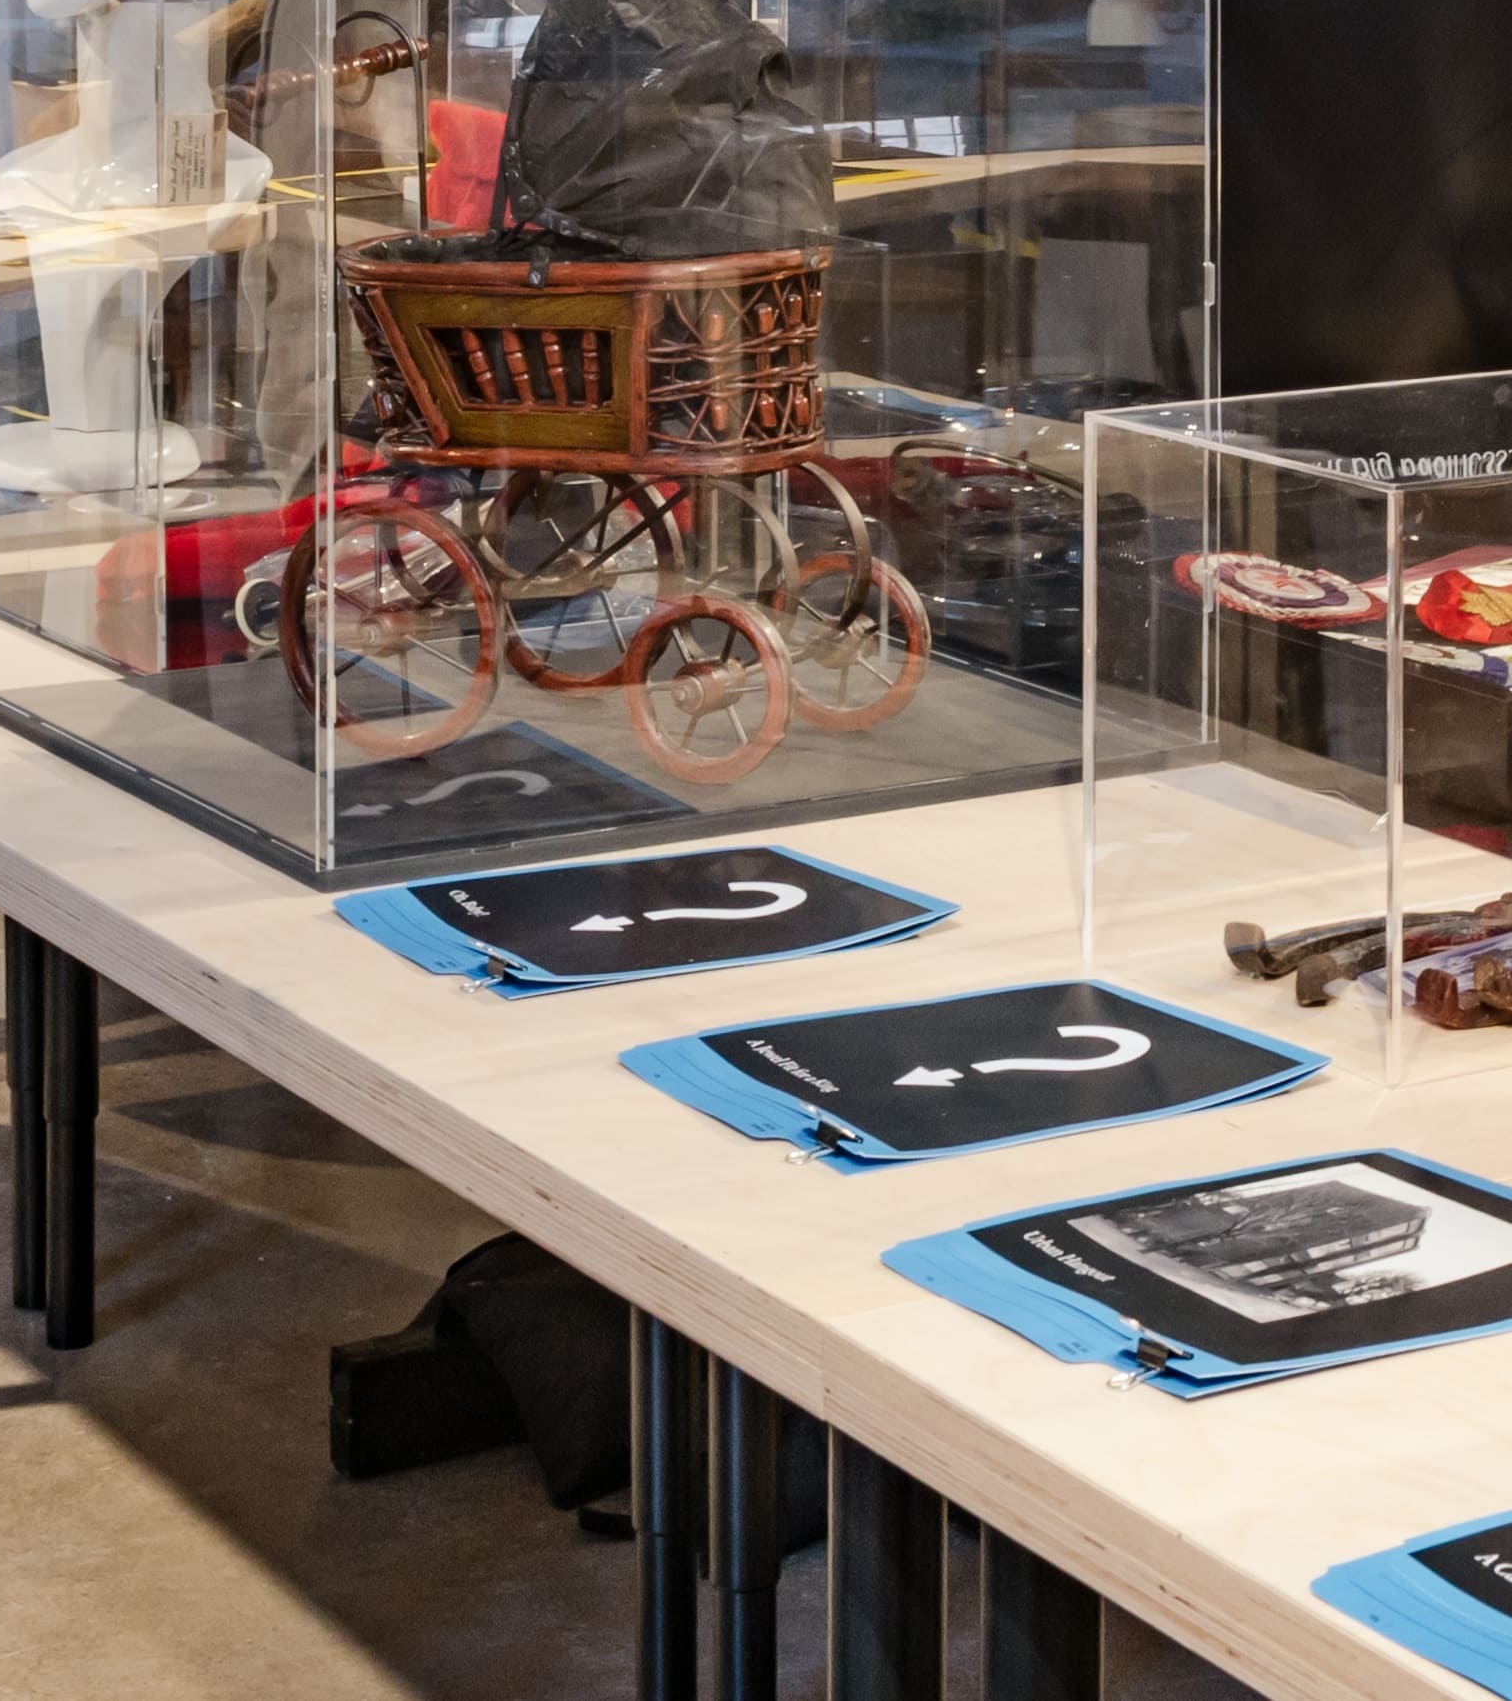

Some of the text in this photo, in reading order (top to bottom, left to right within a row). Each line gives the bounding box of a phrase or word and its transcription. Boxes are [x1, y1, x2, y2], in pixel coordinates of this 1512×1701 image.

[1023, 1230, 1116, 1282] Urban Hangout
[1473, 1553, 1500, 1567] A
